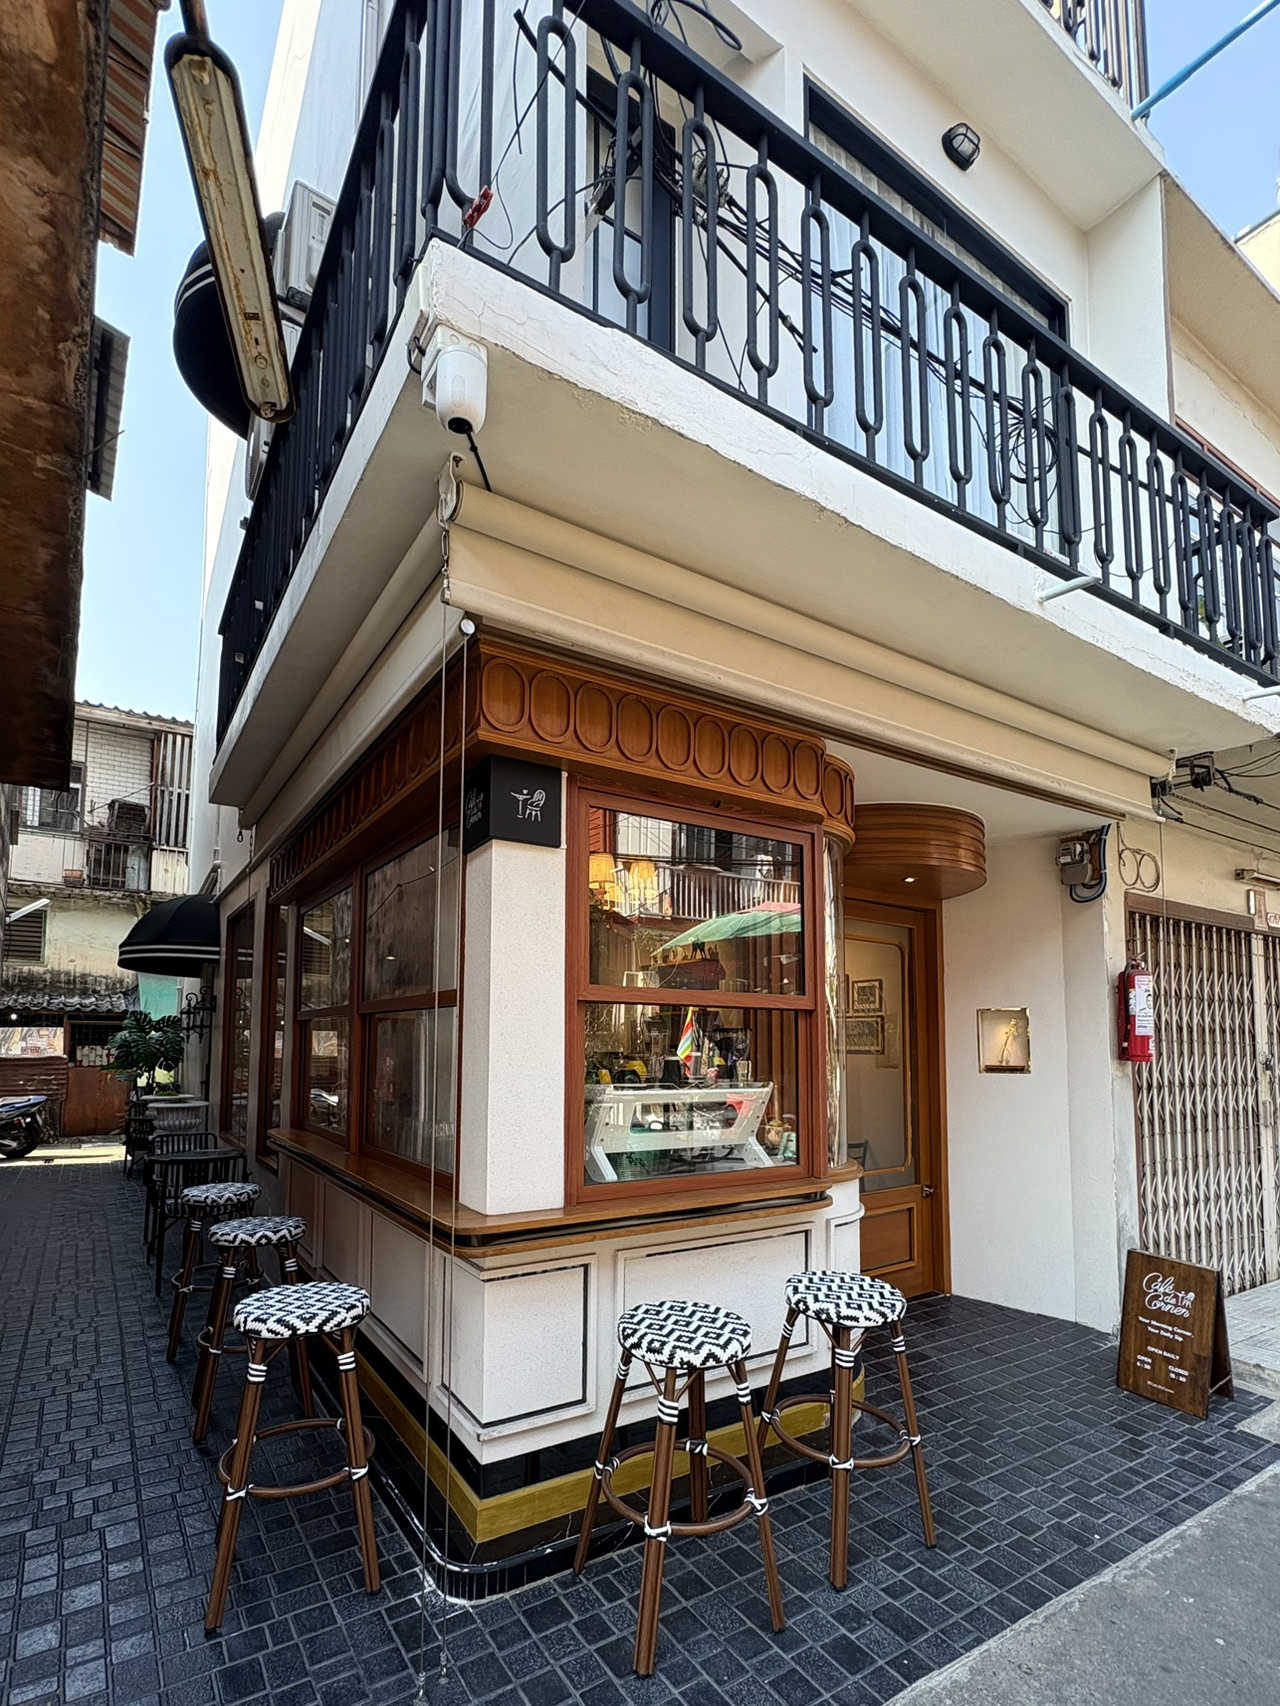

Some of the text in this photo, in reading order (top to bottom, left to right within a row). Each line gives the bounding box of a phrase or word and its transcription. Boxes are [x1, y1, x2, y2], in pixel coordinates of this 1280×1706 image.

[1163, 1293, 1177, 1304] de
[1145, 1292, 1190, 1317] Corner
[1160, 1330, 1173, 1339] Daily
[1147, 1345, 1180, 1360] OPEN DAILY
[1137, 1354, 1152, 1363] OPEN
[1168, 1365, 1189, 1376] CLOSED
